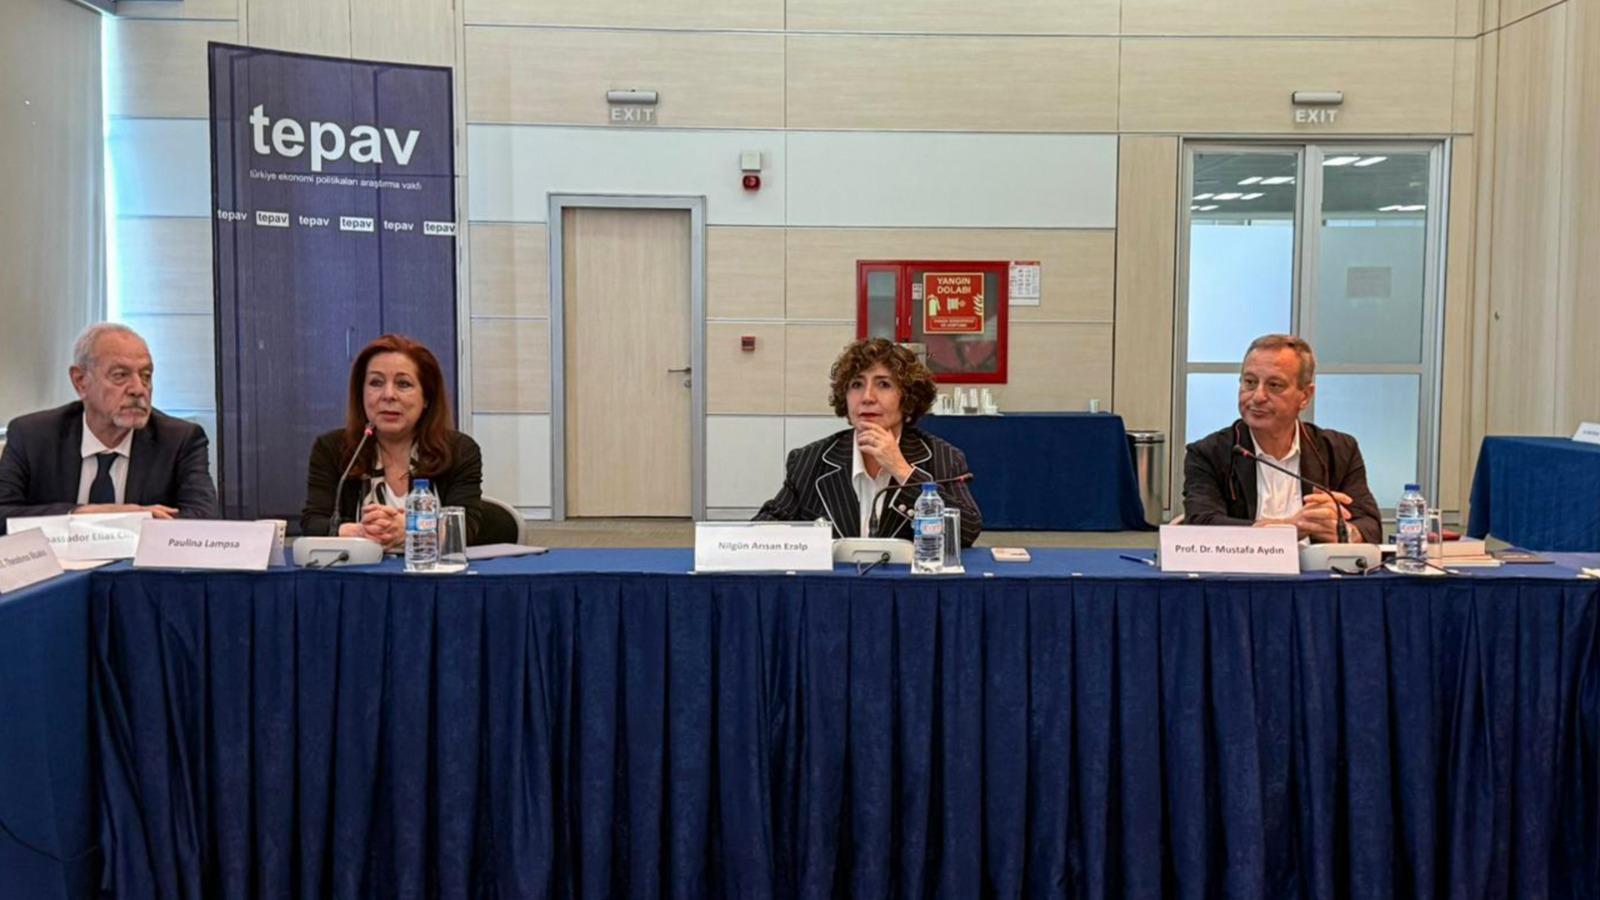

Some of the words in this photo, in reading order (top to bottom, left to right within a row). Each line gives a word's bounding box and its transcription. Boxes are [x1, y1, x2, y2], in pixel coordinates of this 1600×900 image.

[611, 108, 653, 121] EXIT
[1295, 109, 1338, 123] EXIT
[249, 103, 421, 172] tepav
[278, 172, 314, 183] ekonomi
[217, 209, 247, 221] tepav
[257, 213, 288, 225] tepav
[299, 215, 330, 227] tepav
[341, 217, 372, 229] tepav
[383, 220, 414, 231] tepav
[424, 222, 455, 234] tepav
[937, 277, 971, 285] YANGIN
[937, 286, 971, 294] DOLABI
[48, 533, 89, 544] assador
[168, 538, 202, 548] Paulina
[205, 539, 240, 550] Lampsa
[718, 541, 749, 551] Nilgün
[784, 542, 808, 551] Eralp
[1175, 544, 1197, 553] Prof.
[1200, 545, 1213, 553] Dr.
[1216, 545, 1255, 554] Mustafa
[1257, 546, 1285, 555] Aydın
